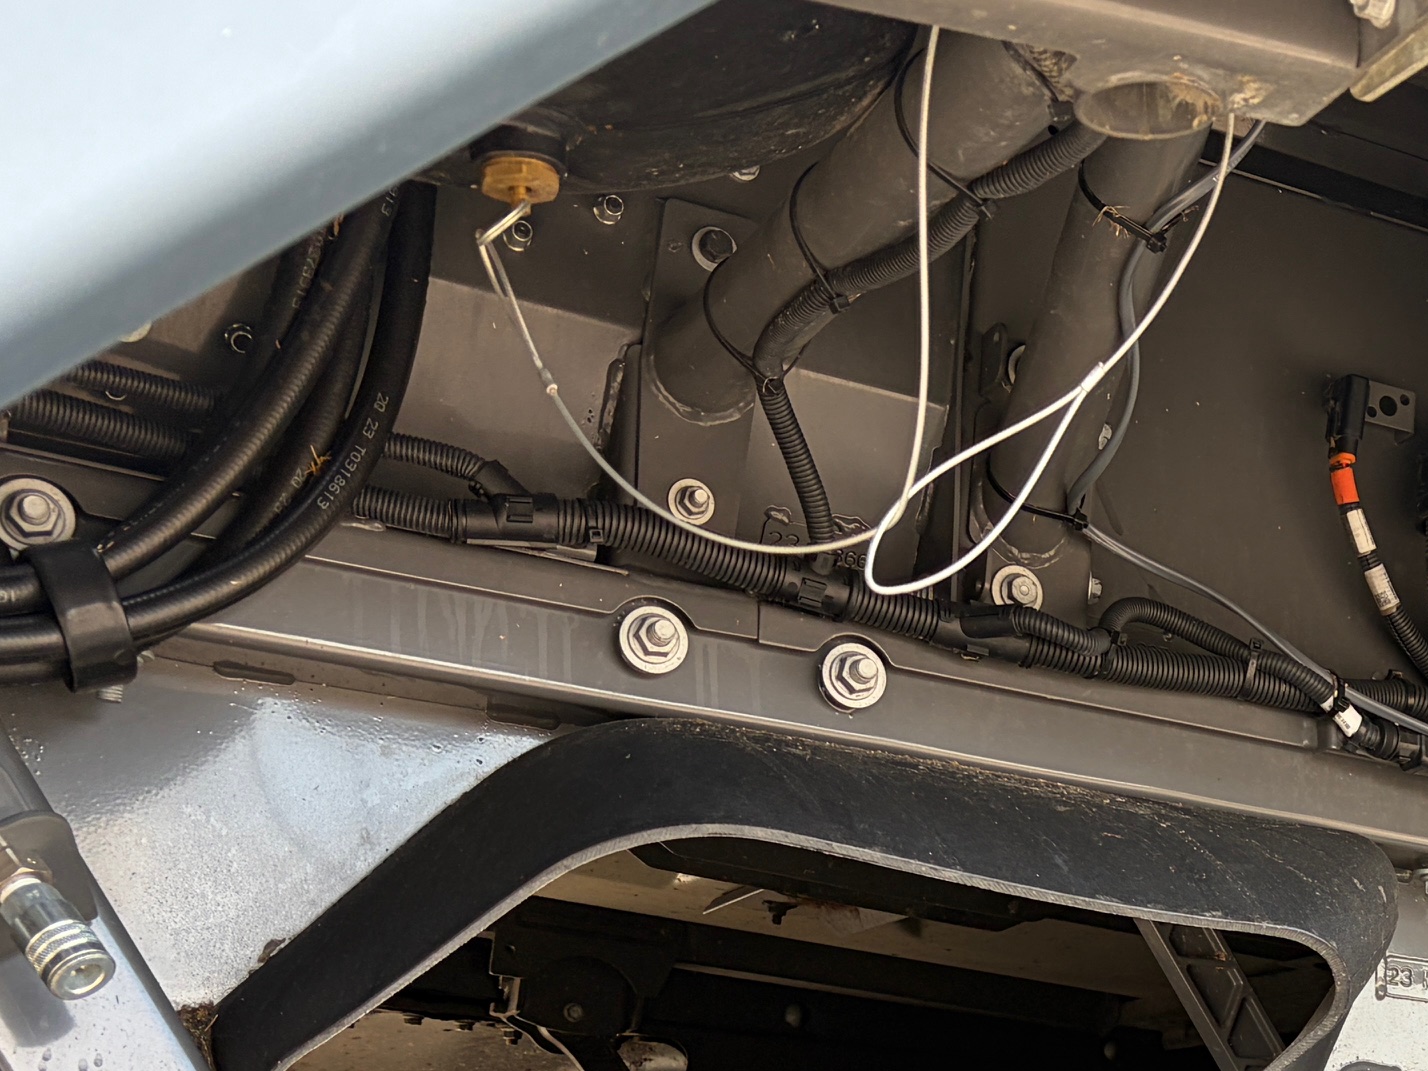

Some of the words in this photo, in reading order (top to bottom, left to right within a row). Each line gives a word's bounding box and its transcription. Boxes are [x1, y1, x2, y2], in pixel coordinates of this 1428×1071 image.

[373, 392, 389, 412] 20
[363, 417, 379, 439] 23
[317, 444, 367, 510] T0318613
[1386, 967, 1412, 989] 23
